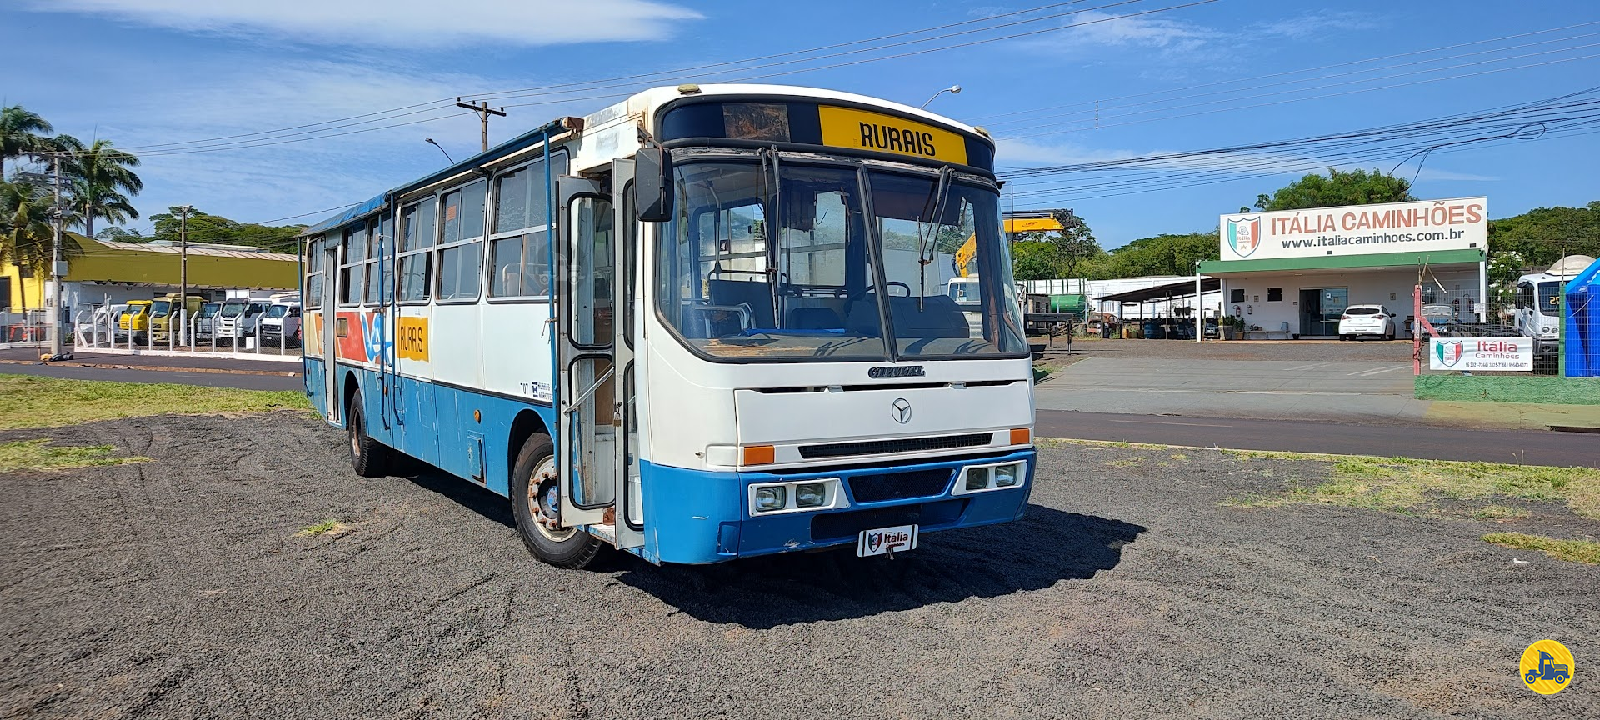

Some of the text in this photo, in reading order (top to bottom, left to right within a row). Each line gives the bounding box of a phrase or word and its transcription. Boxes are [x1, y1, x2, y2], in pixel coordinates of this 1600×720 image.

[859, 122, 936, 157] RURAIS
[1271, 201, 1483, 235] ITÁLIA CAMINHÕES
[1281, 228, 1464, 249] www.italiacaminhoes.com.br
[1477, 340, 1518, 353] Itália
[884, 531, 908, 544] Itália
